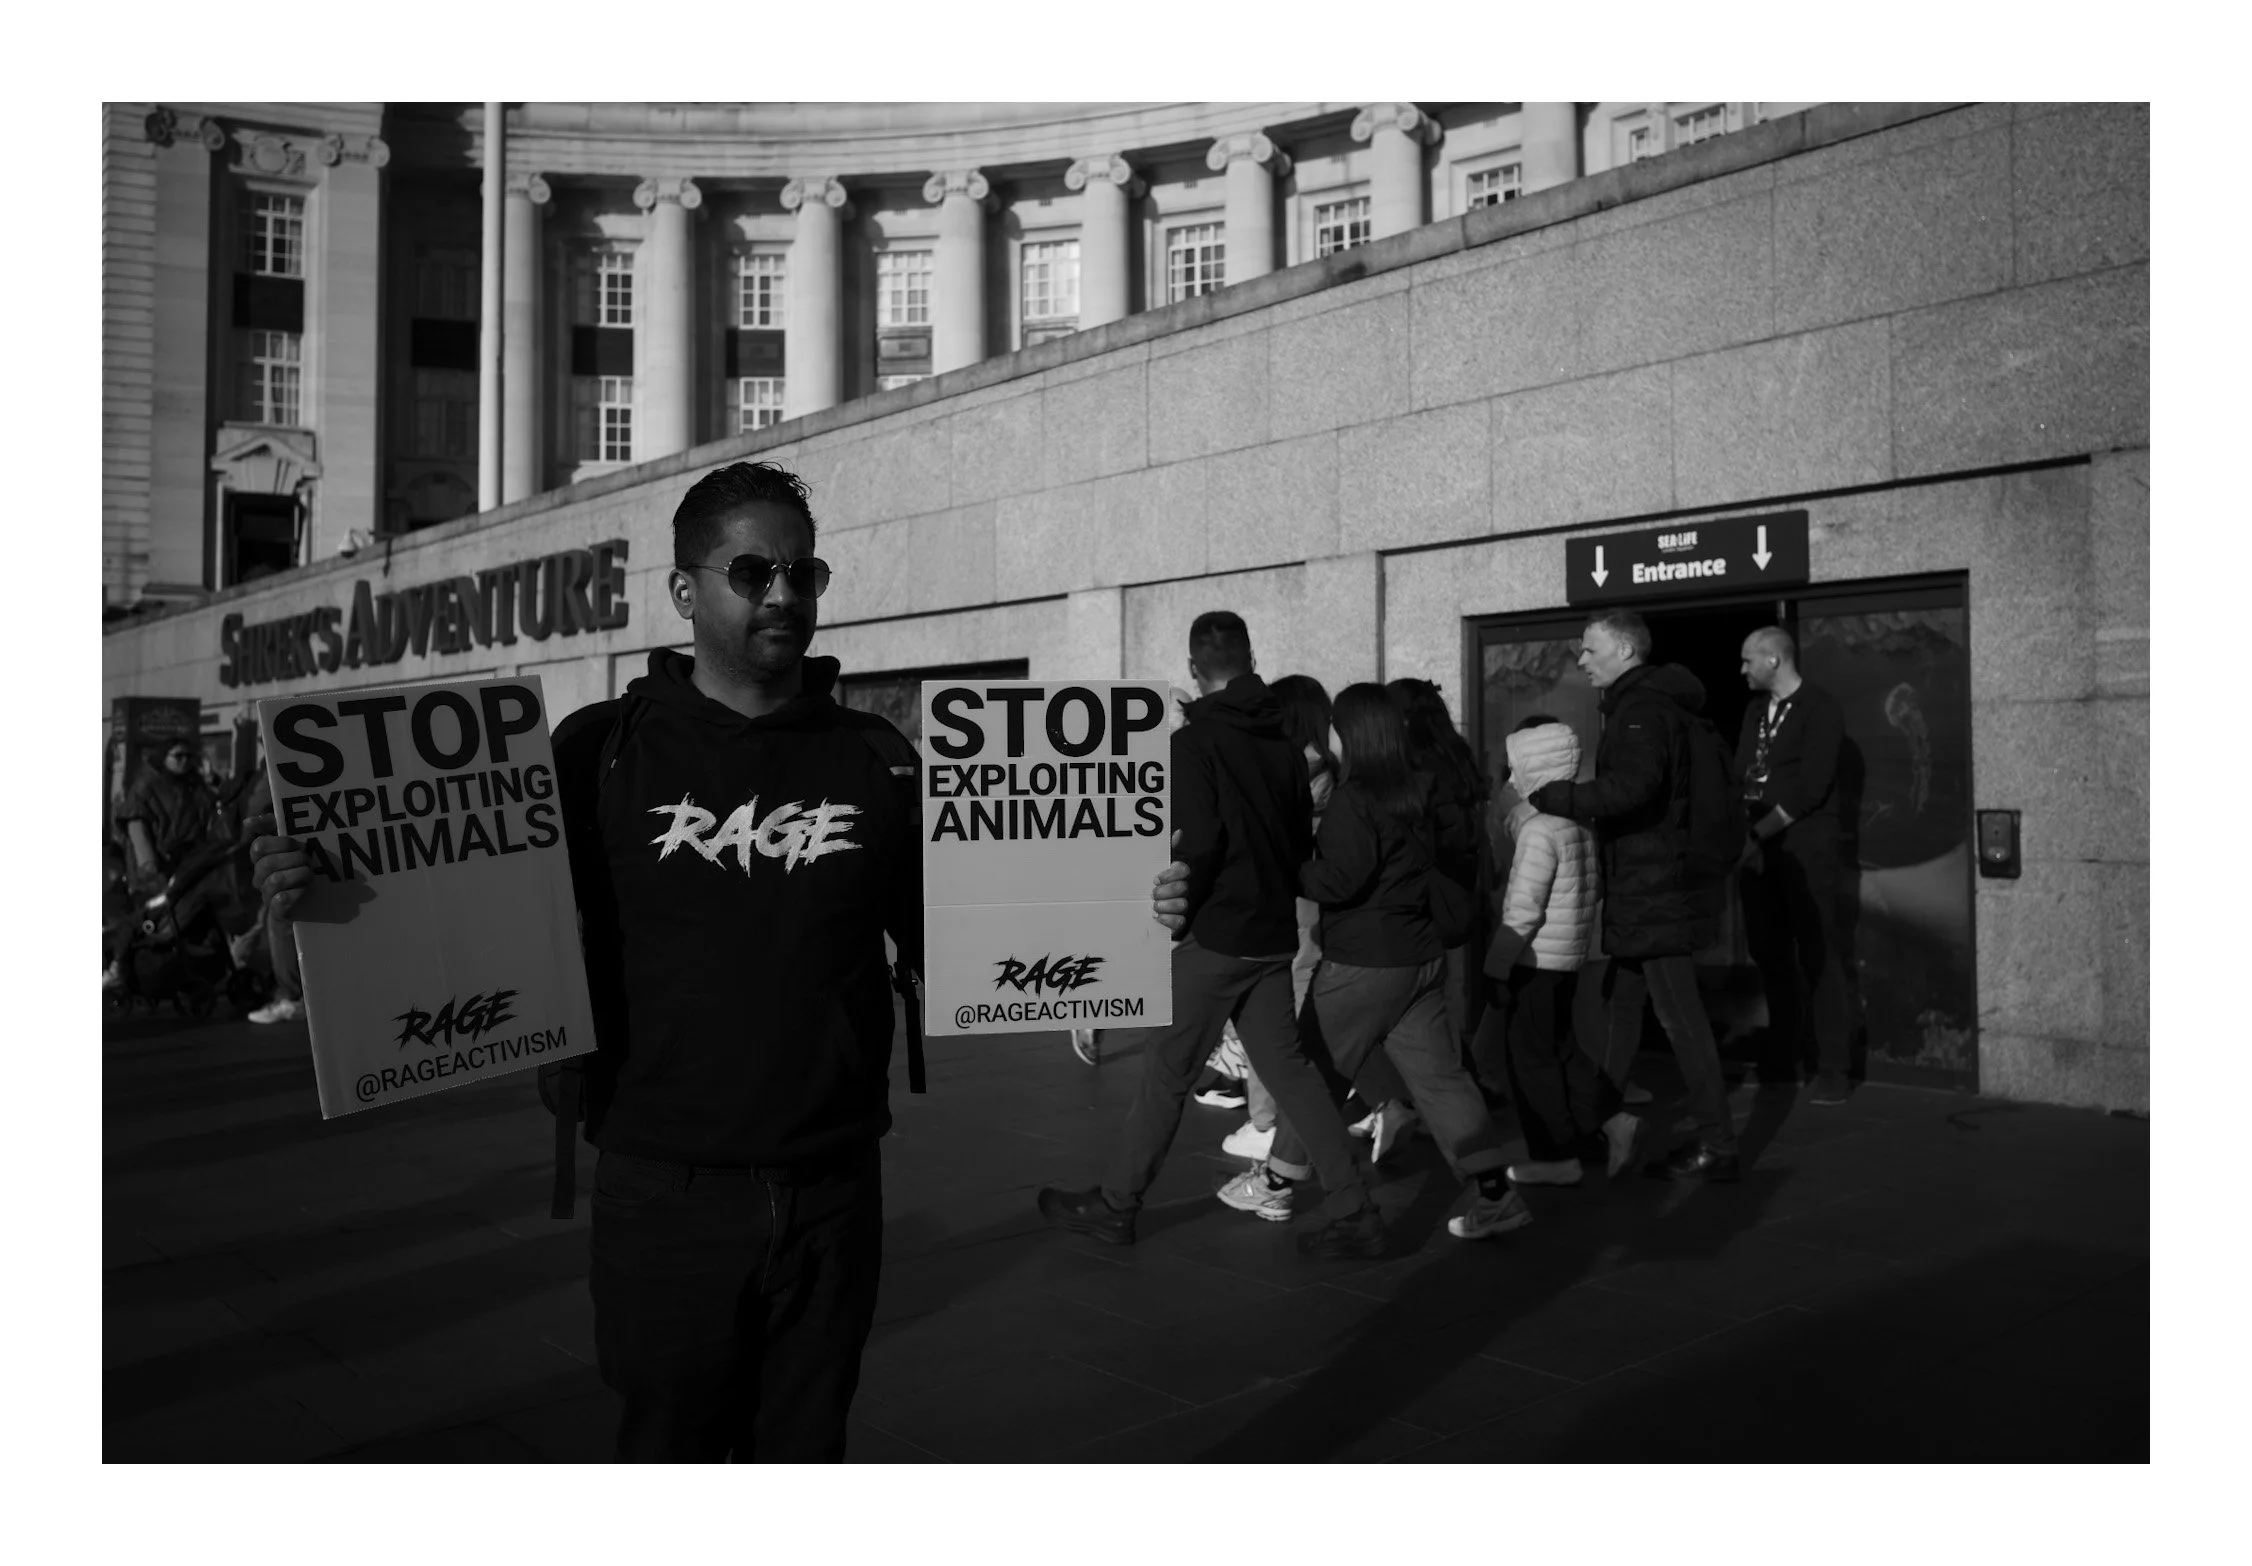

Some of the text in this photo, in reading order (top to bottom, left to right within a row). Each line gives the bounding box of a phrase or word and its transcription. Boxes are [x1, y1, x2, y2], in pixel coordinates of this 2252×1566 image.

[1632, 557, 1727, 584] Entrance
[220, 538, 629, 688] SHREK'S ADVENTURE
[272, 684, 542, 788] STOP
[929, 686, 1165, 759] STOP
[281, 764, 554, 836] EXPLOITING
[929, 761, 1165, 797] EXPLOITING
[306, 803, 560, 883] ANIMALS
[646, 789, 864, 878] RAGE
[931, 796, 1164, 842] ANIMALS
[992, 952, 1107, 997] RAGE
[391, 989, 520, 1051] RAGE
[955, 998, 1145, 1029] @RAGEACTIVISM
[356, 1026, 568, 1104] @RAGEACTIVISM
